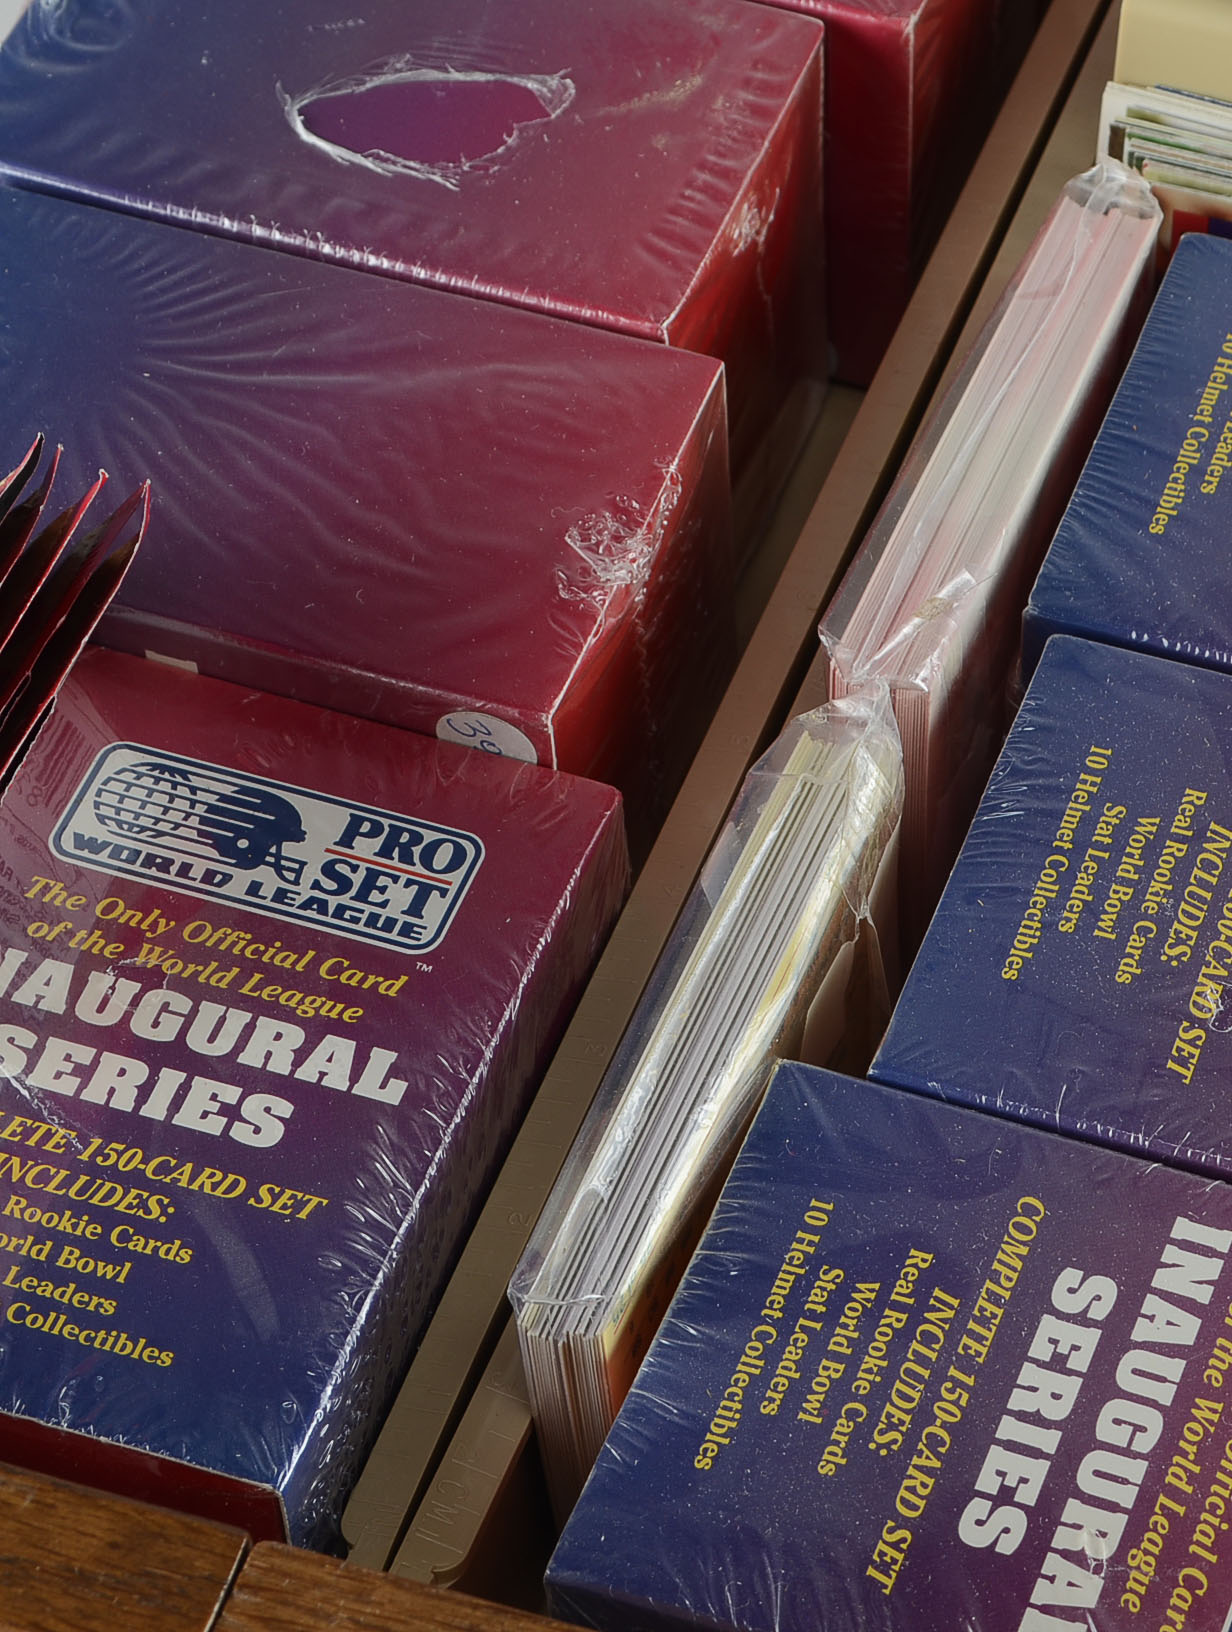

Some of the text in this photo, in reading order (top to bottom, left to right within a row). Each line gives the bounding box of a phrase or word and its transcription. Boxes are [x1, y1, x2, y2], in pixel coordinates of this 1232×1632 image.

[1148, 426, 1209, 535] Collectibles
[71, 830, 234, 891] WORLD
[244, 876, 429, 943] LEAGUE
[310, 852, 451, 920] SET
[332, 809, 470, 876] PRO
[1001, 745, 1113, 981] 10 Helmet Collectibles
[1058, 801, 1127, 933] Stat Leaders
[1093, 815, 1161, 940] World Bowl
[1115, 787, 1208, 985] Real Rookie Cards
[24, 875, 409, 999] The Only Official Card
[27, 921, 365, 1026] of the World League
[1166, 1020, 1206, 1085] SET
[2, 1194, 194, 1264] Rookie Cards
[77, 1138, 329, 1220] 150-CARD SET
[2, 1266, 117, 1316] Leaders
[55, 1245, 132, 1284] Bowl
[5, 1301, 175, 1367] Collectibles
[693, 1197, 834, 1471] 10 Helmet Collectibles
[759, 1264, 844, 1416] Stat Leaders
[797, 1280, 880, 1424] World Bowl
[817, 1247, 935, 1477] Real Rookie Cards
[868, 1286, 961, 1457] INCLUDES:
[865, 1195, 1045, 1596] COMPLETE 150-CARD SET
[957, 1266, 1118, 1556] SERIES
[1164, 1397, 1223, 1494] World
[1120, 1493, 1186, 1614] League
[1160, 1567, 1208, 1632] Car
